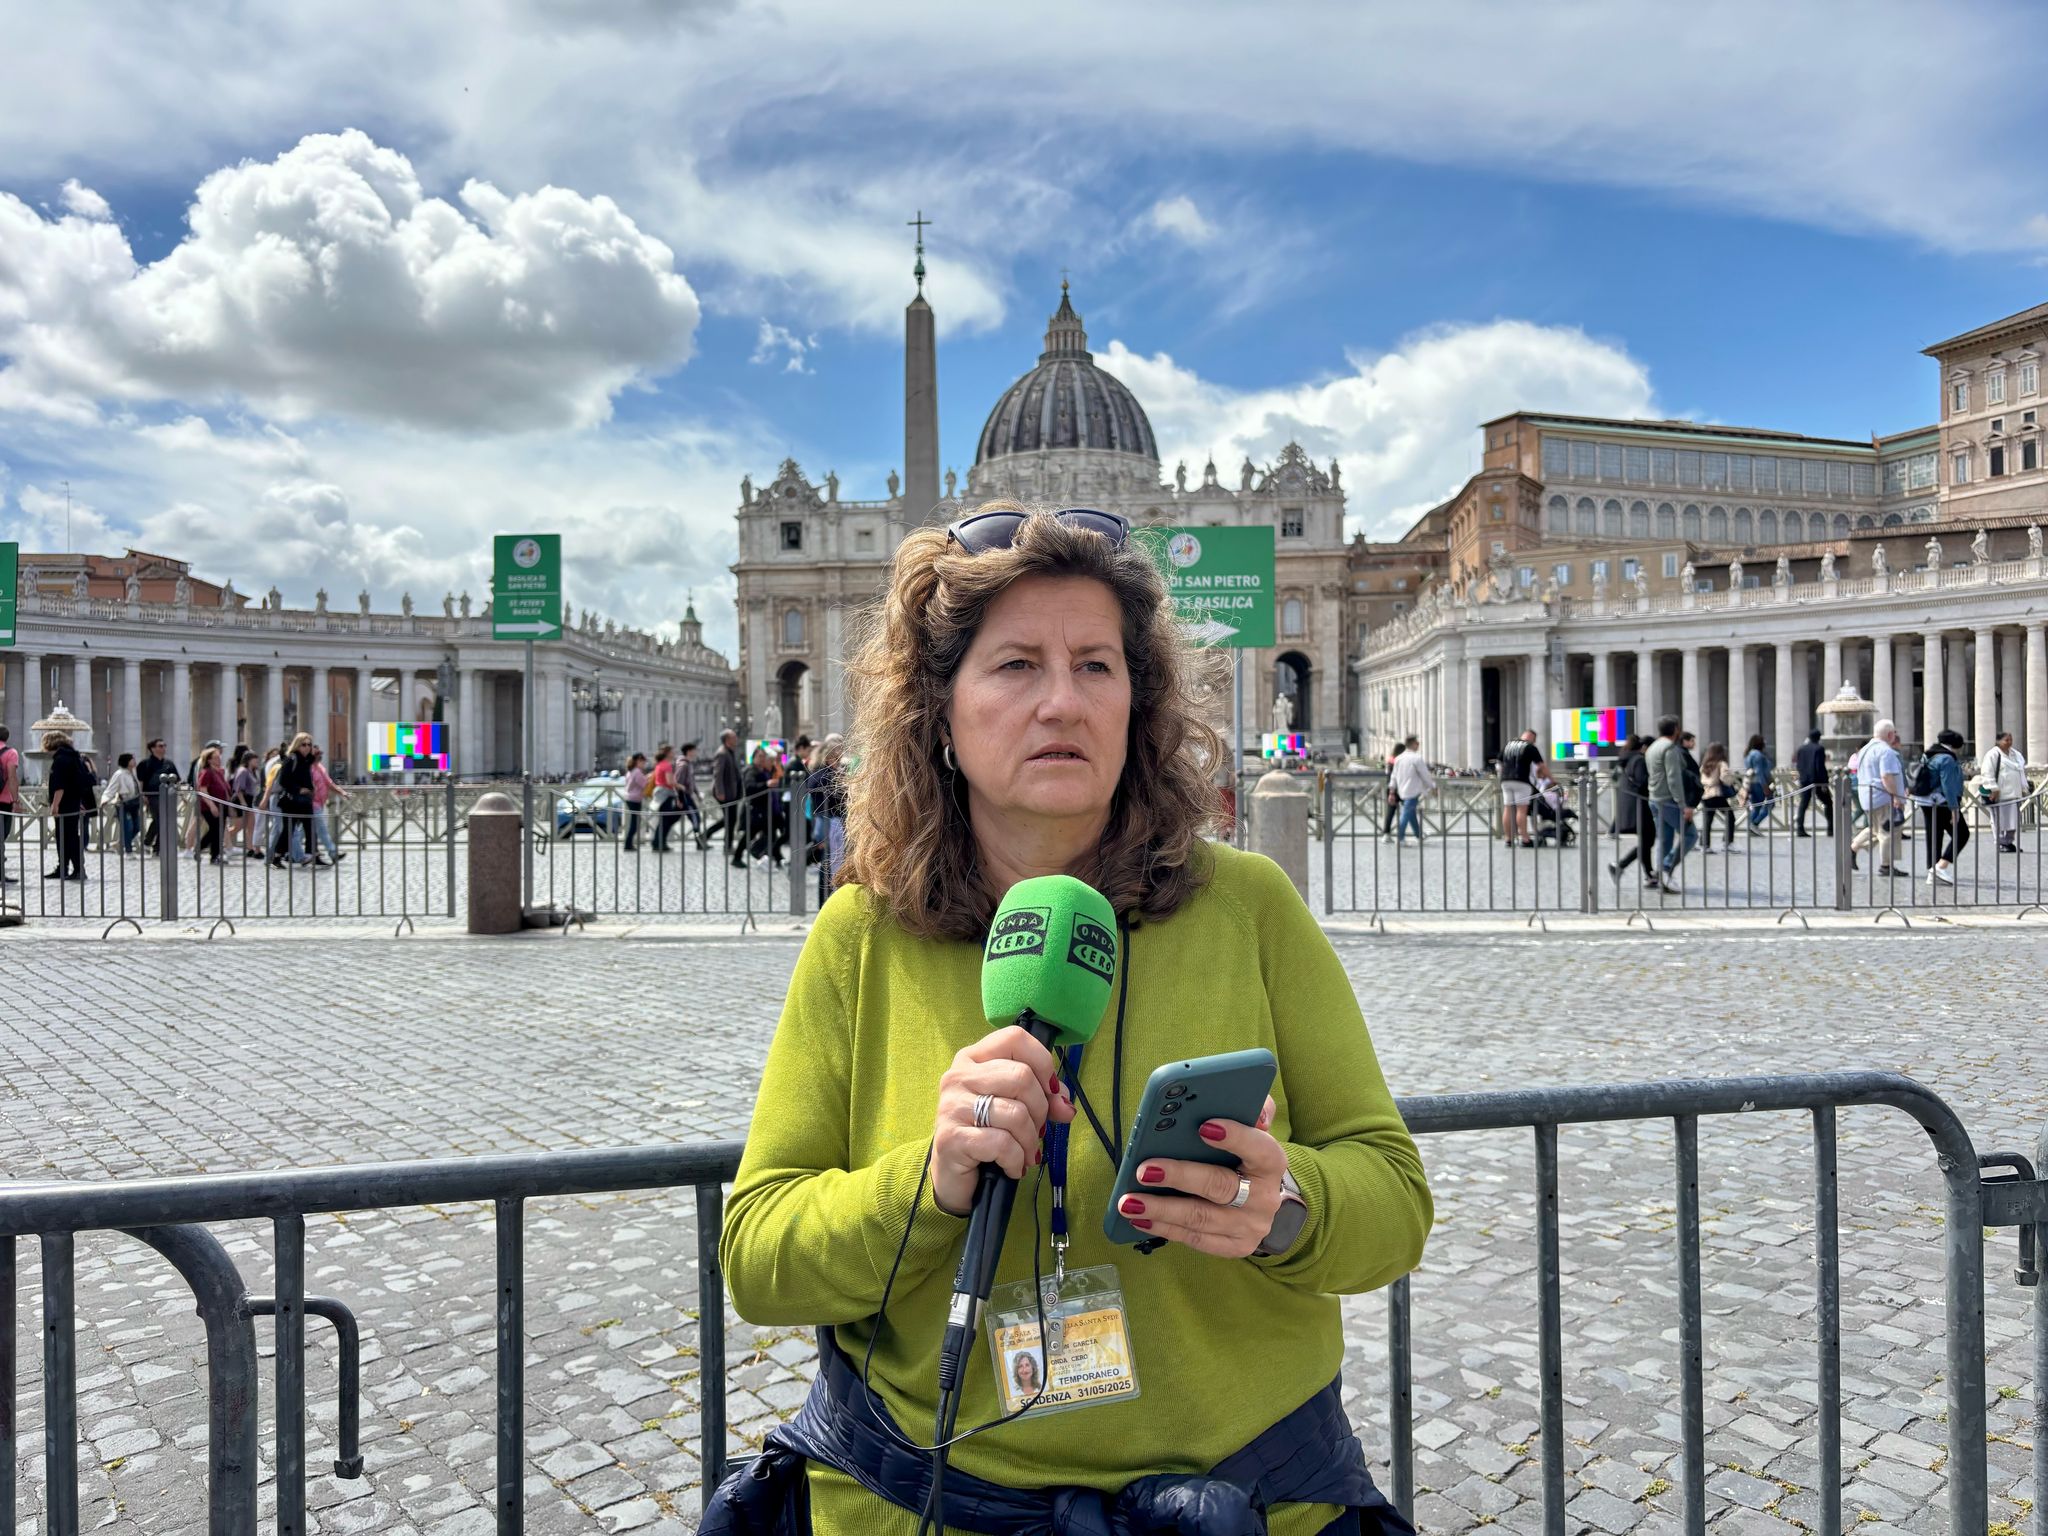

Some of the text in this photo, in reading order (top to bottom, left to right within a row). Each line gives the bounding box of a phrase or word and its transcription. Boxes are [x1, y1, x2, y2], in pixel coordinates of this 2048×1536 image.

[1185, 576, 1211, 588] SAN
[1214, 575, 1260, 588] PIETRO
[1195, 596, 1253, 609] BASILICA
[999, 917, 1038, 930] ONDA
[996, 935, 1035, 950] CERO
[1082, 926, 1113, 952] ONDA
[1081, 946, 1111, 972] CERO
[1051, 1358, 1068, 1366] ONDA
[1058, 1368, 1120, 1385] TEMPORANEO
[1077, 1380, 1131, 1398] 31/05/2025
